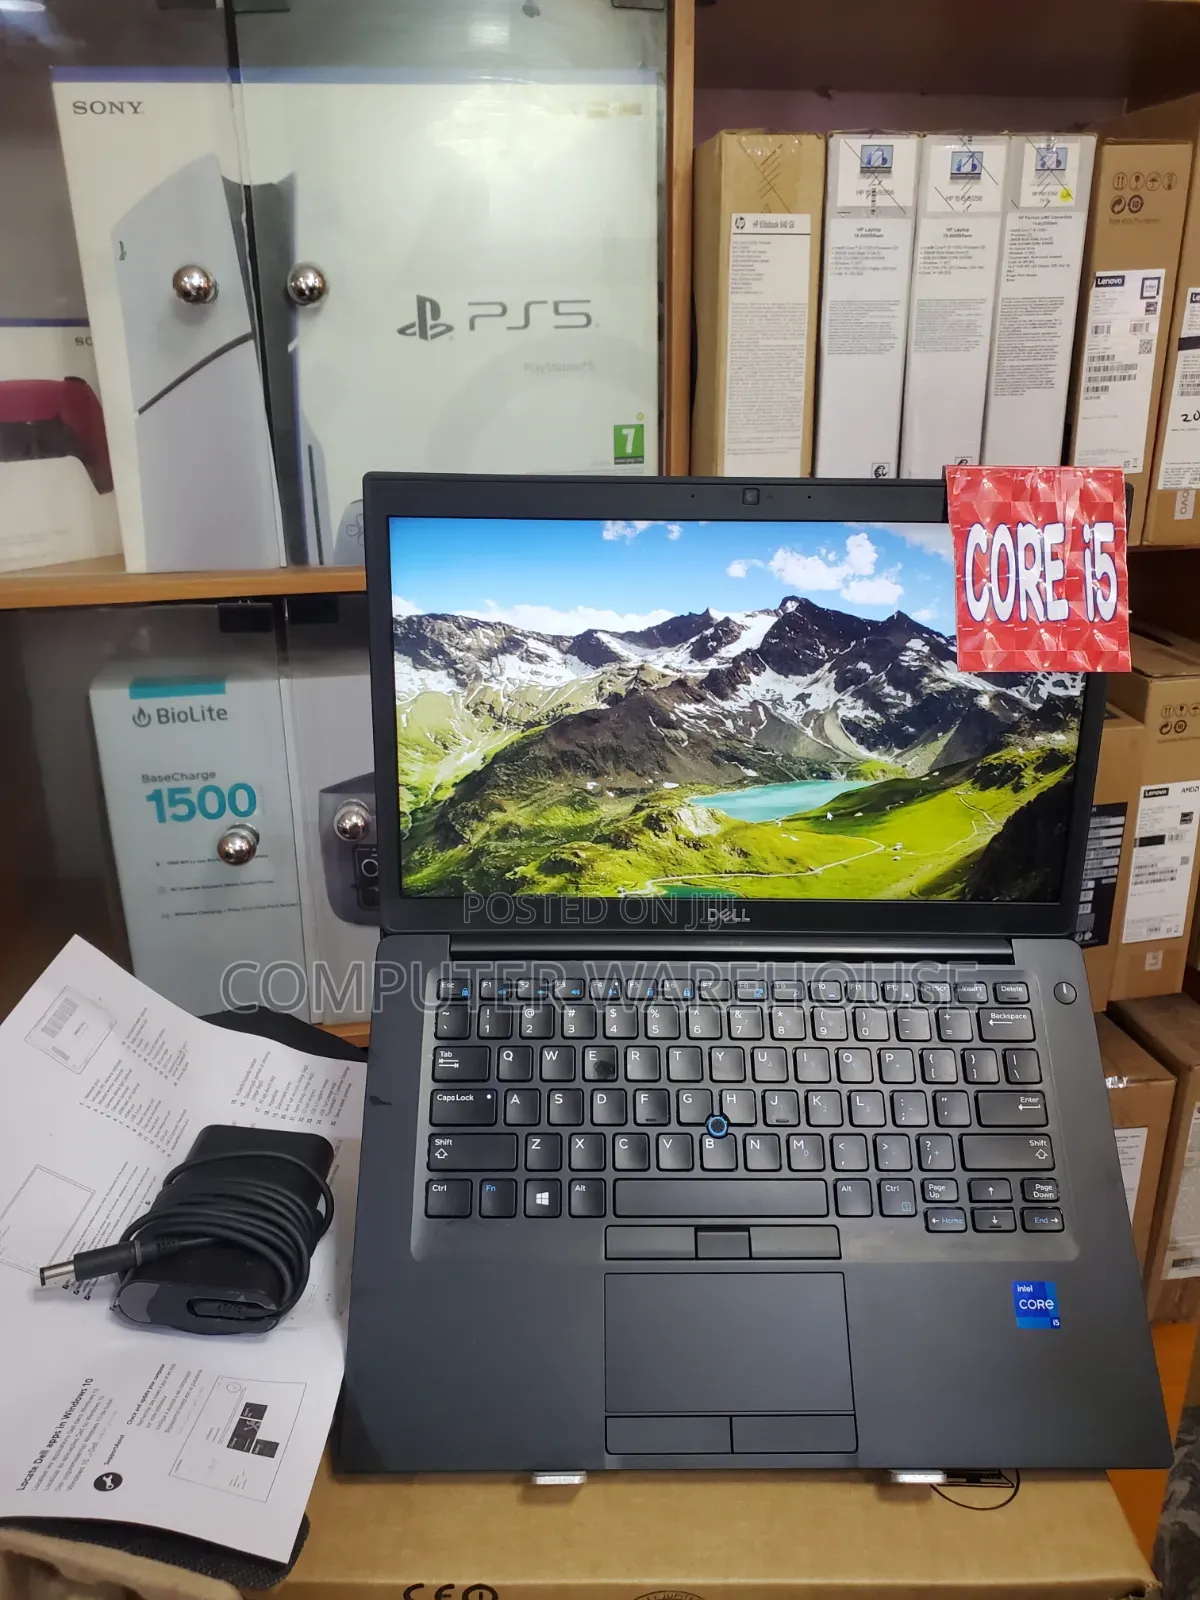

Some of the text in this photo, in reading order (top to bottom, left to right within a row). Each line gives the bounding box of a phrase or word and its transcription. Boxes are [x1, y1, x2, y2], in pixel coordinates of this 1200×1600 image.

[72, 100, 143, 115] SONY
[1097, 277, 1123, 285] Lenovo
[468, 300, 593, 331] PS5
[622, 428, 636, 453] 7
[964, 521, 1118, 622] CORE i5
[156, 706, 229, 725] BioLite
[141, 770, 217, 784] BaseCharge
[145, 782, 257, 824] 1500
[707, 908, 751, 923] DELL
[441, 981, 455, 989] Esc
[1001, 985, 1023, 993] Delete
[990, 1012, 1028, 1021] Backspace
[484, 1025, 490, 1033] 1
[526, 1024, 533, 1033] 2
[568, 1025, 575, 1033] 3
[610, 1025, 618, 1033] 4
[652, 1025, 659, 1033] 5
[693, 1025, 701, 1034] 6
[736, 1025, 742, 1034] 7
[778, 1026, 785, 1035] 8
[819, 1026, 827, 1036] 9
[861, 1027, 869, 1036] 0
[503, 1051, 513, 1062] Q
[544, 1051, 559, 1061] W
[589, 1051, 597, 1061] E
[631, 1051, 640, 1061] R
[673, 1051, 682, 1061] T
[715, 1051, 725, 1061] Y
[758, 1052, 768, 1062] U
[842, 1053, 853, 1063] O
[885, 1053, 894, 1063] P
[437, 1093, 474, 1103] Caps Lock
[510, 1094, 520, 1104] A
[554, 1094, 563, 1104] S
[597, 1094, 607, 1104] D
[640, 1094, 649, 1104] F
[682, 1094, 692, 1104] G
[727, 1094, 736, 1104] H
[770, 1095, 778, 1106] J
[813, 1095, 822, 1106] K
[856, 1095, 865, 1106] L
[1020, 1096, 1040, 1104] Enter
[434, 1138, 453, 1146] Shift
[531, 1138, 541, 1149] Z
[575, 1138, 585, 1149] X
[619, 1138, 628, 1149] C
[663, 1138, 673, 1149] V
[705, 1138, 715, 1149] B
[750, 1140, 760, 1150] N
[793, 1140, 805, 1150] M
[1029, 1139, 1048, 1148] Shift
[432, 1184, 447, 1192] Ctrl
[485, 1184, 496, 1192] Fn
[574, 1184, 586, 1192] Alt
[841, 1184, 852, 1192] Alt
[885, 1184, 900, 1192] Ctrl
[928, 1184, 946, 1193] Page
[1035, 1184, 1053, 1193] Page
[929, 1191, 940, 1200] Up
[1033, 1191, 1054, 1199] Down
[941, 1216, 963, 1225] Home
[1034, 1216, 1049, 1224] End
[1017, 1284, 1033, 1293] intel
[15, 1378, 94, 1491] Locate Dell apps in Windows 10
